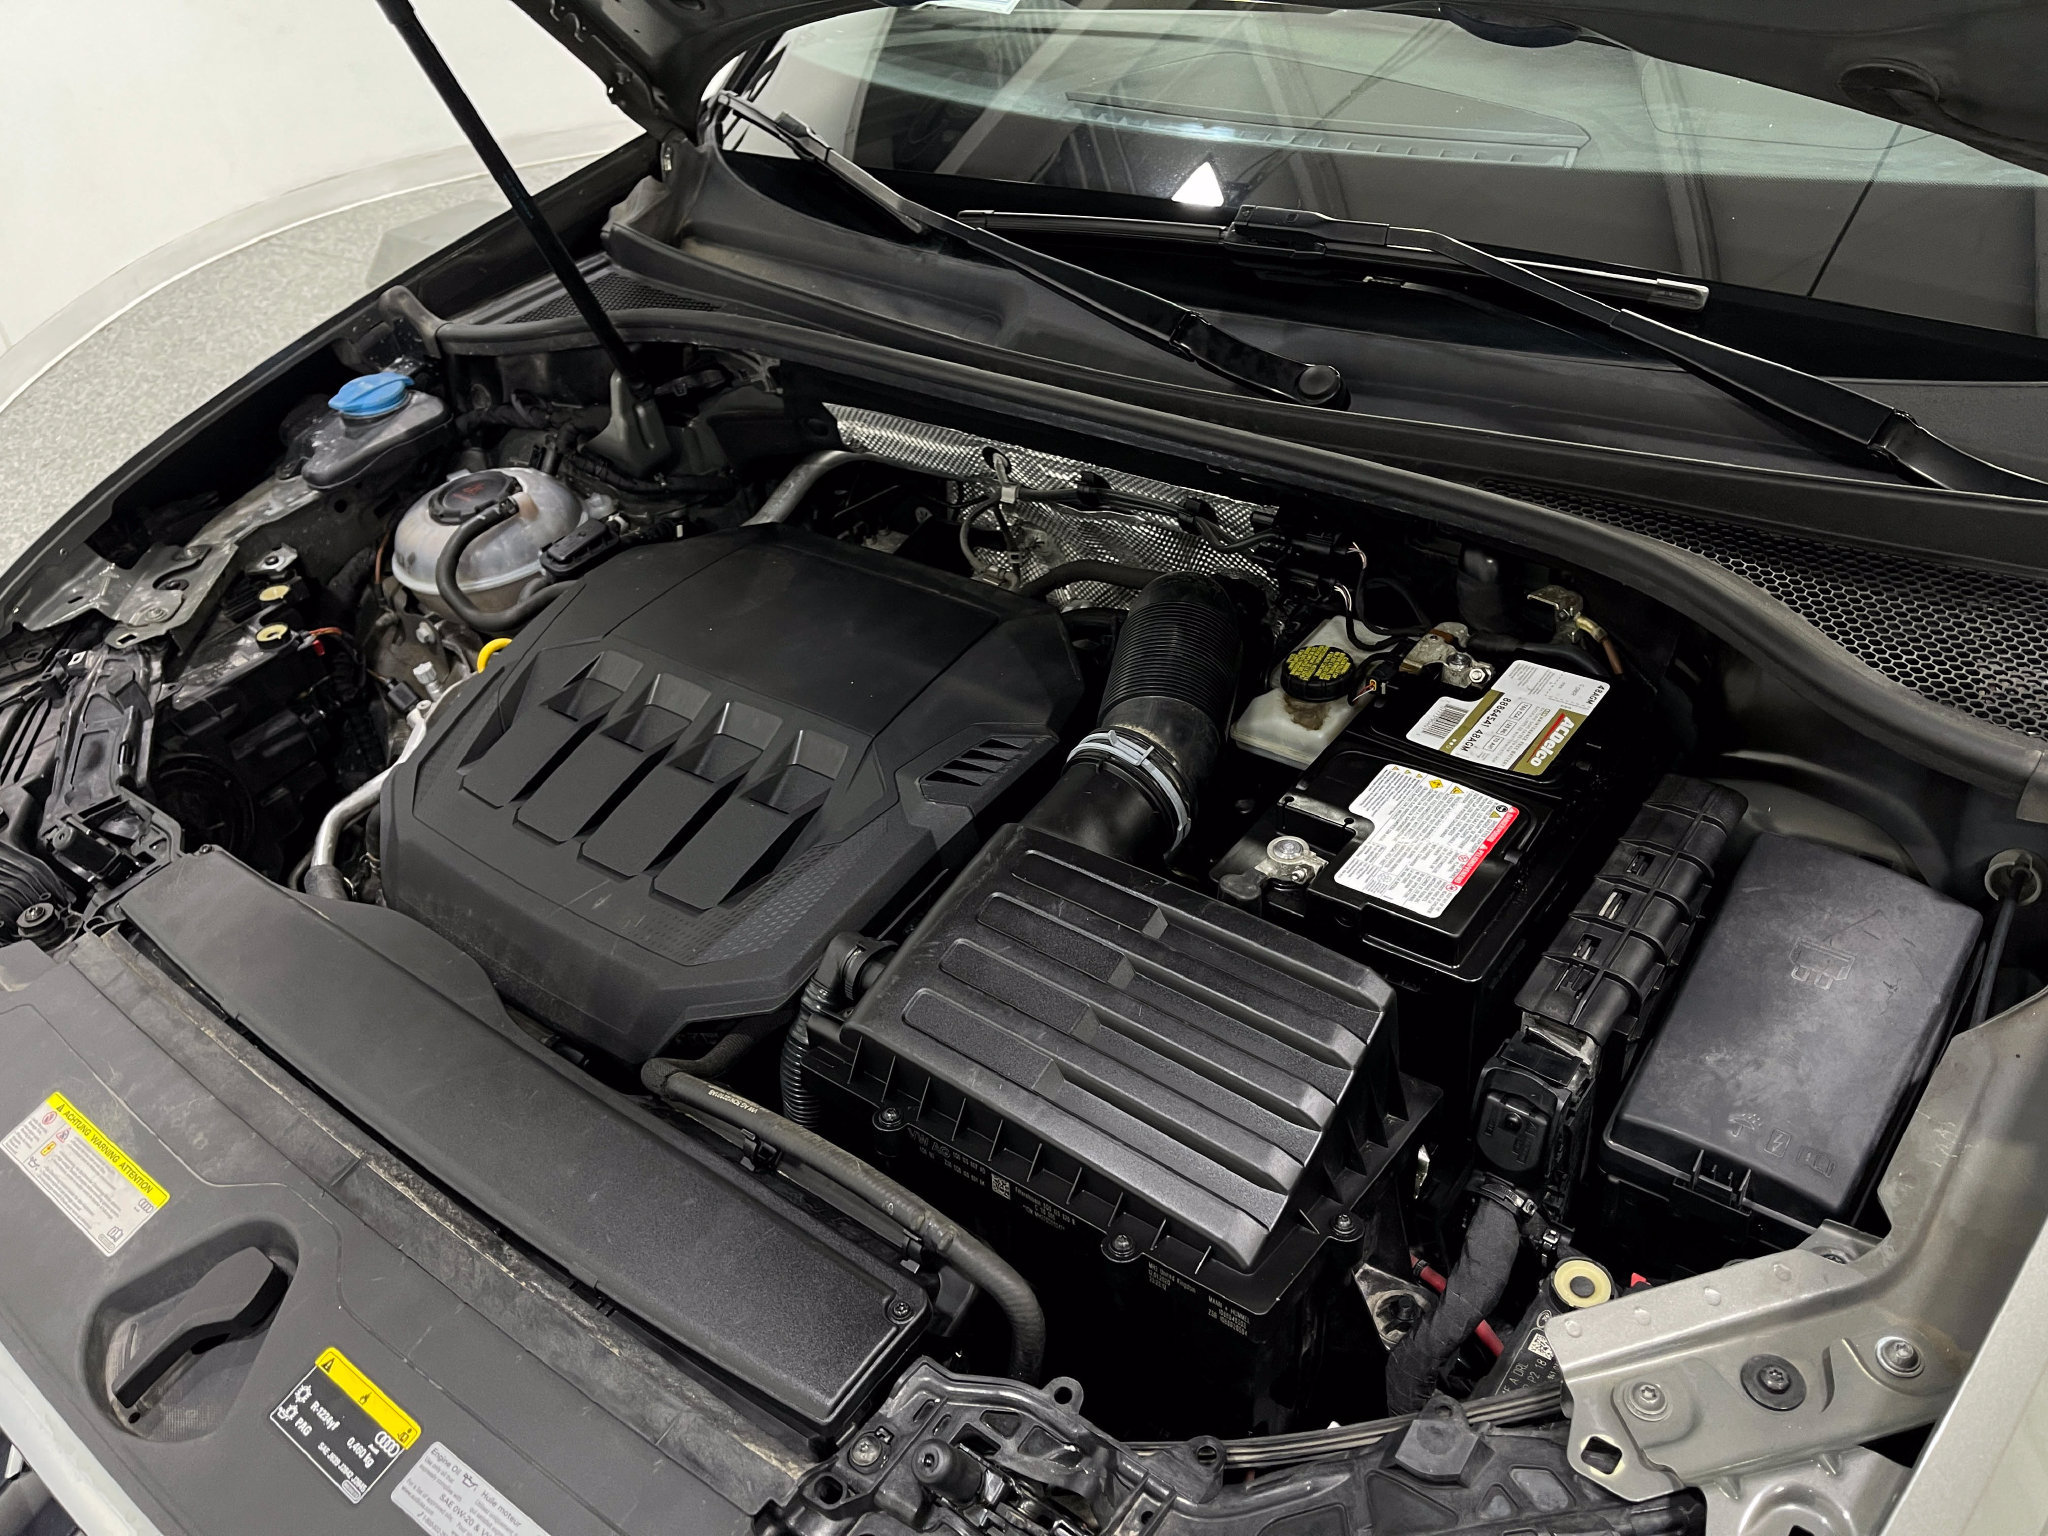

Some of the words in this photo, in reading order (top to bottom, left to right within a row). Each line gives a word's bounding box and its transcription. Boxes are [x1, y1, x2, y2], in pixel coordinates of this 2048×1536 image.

[1586, 684, 1604, 704] 48AGM
[1460, 729, 1484, 752] 48AGM
[1530, 716, 1574, 766] ACDelco
[64, 1110, 92, 1136] ACHTUNG
[91, 1134, 120, 1163] WARNING
[120, 1162, 153, 1194] ATTENTION
[1513, 1362, 1528, 1376] DRL
[1534, 1358, 1547, 1369] 18
[295, 1417, 312, 1436] PAG
[318, 1442, 330, 1455] SAE
[310, 1400, 340, 1431] R-1234yf
[346, 1437, 367, 1458] 0,460
[363, 1452, 374, 1468] kg
[430, 1448, 451, 1467] Engine
[452, 1465, 462, 1476] Oil
[440, 1494, 455, 1508] SAE
[453, 1505, 474, 1526] 0W-20
[474, 1524, 480, 1532] &
[481, 1490, 498, 1507] Huile
[498, 1506, 522, 1527] moteur
